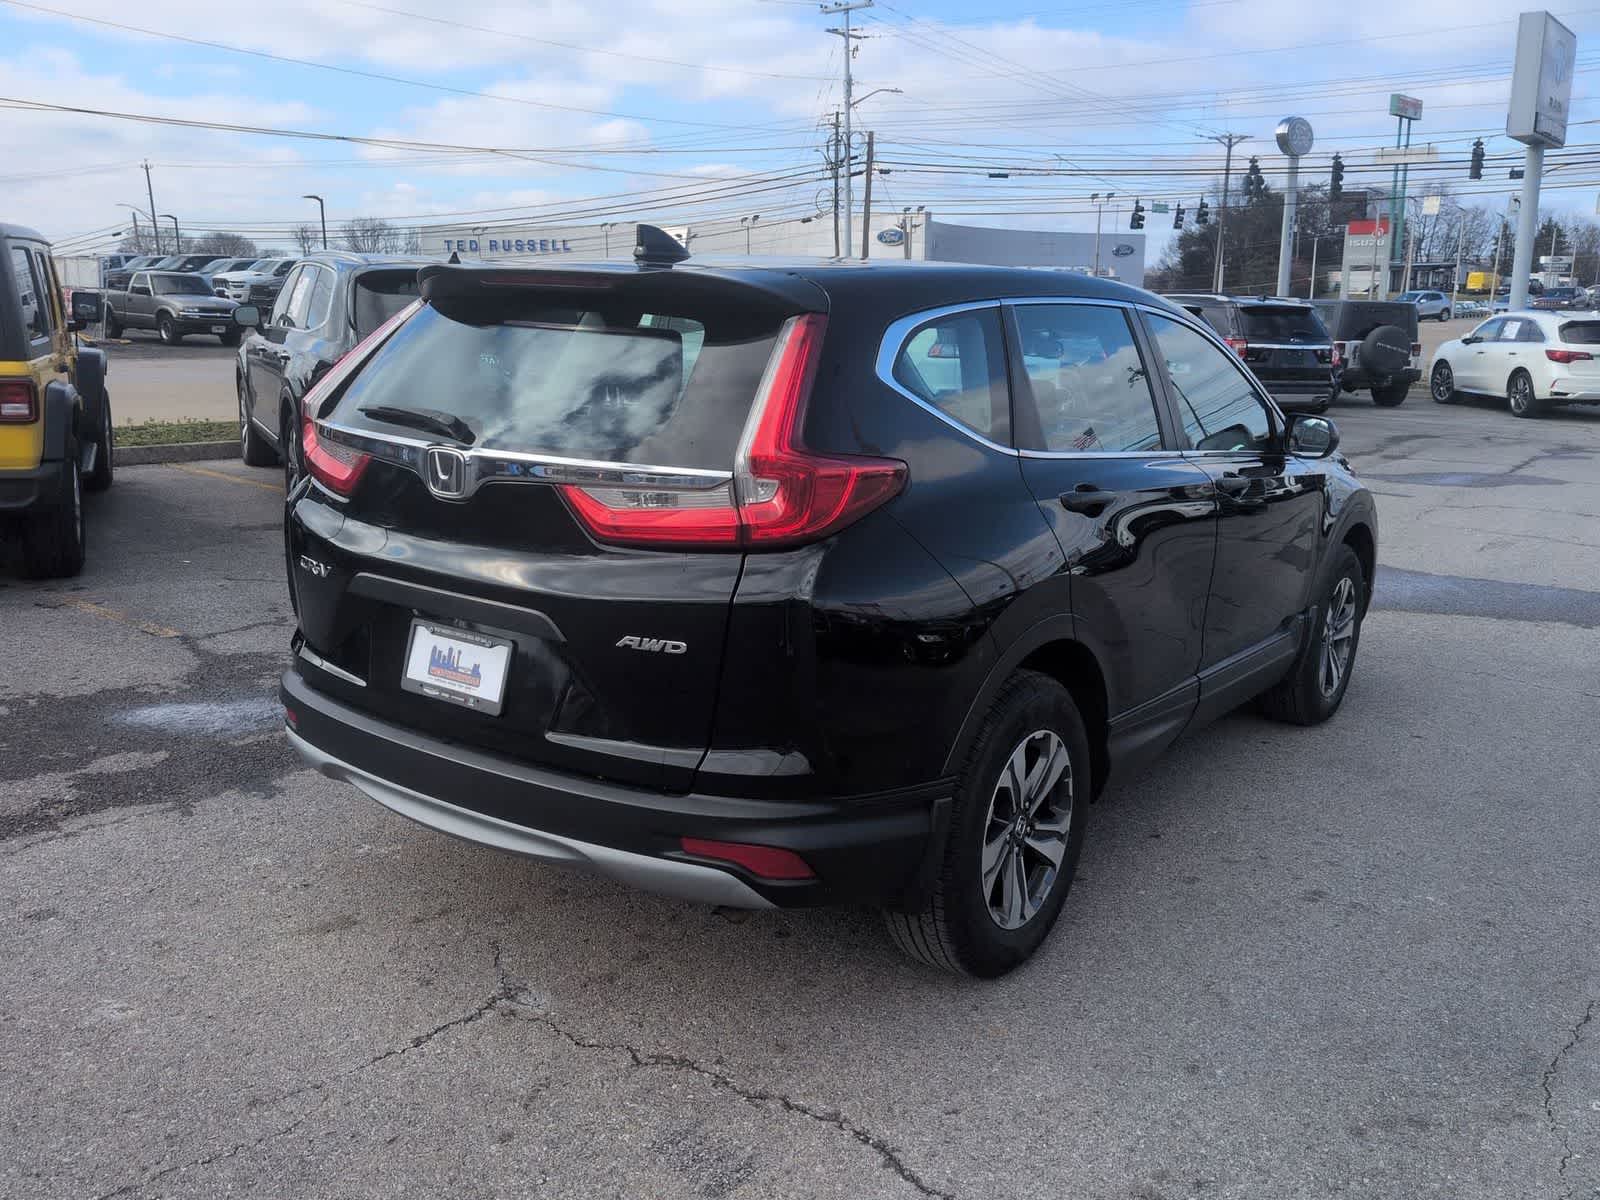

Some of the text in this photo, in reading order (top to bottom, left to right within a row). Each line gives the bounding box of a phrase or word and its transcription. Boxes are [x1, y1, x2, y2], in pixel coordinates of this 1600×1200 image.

[444, 239, 571, 252] TED RUSSELL
[615, 635, 687, 654] AWD
